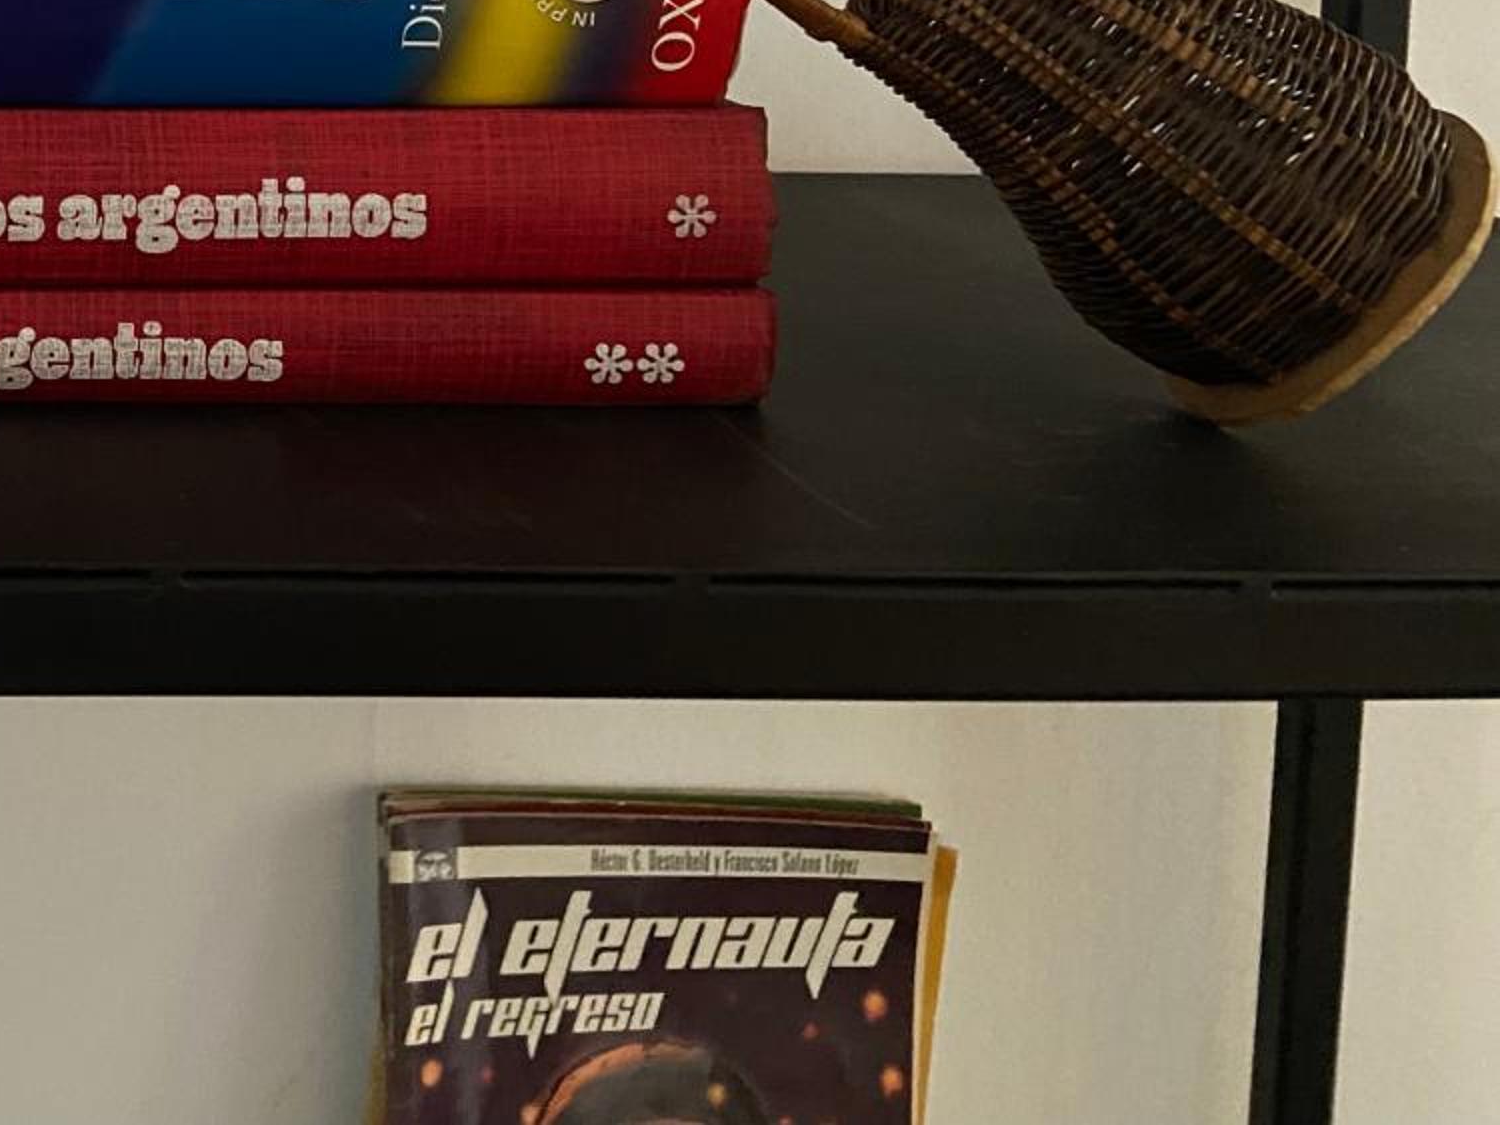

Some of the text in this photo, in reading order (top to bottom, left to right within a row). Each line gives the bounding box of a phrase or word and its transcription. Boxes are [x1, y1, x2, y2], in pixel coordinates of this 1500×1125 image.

[571, 11, 596, 27] IN
[57, 176, 427, 254] argentinos
[781, 851, 822, 874] Solano
[405, 886, 895, 1005] el eternauta
[404, 978, 665, 1060] el regreso
